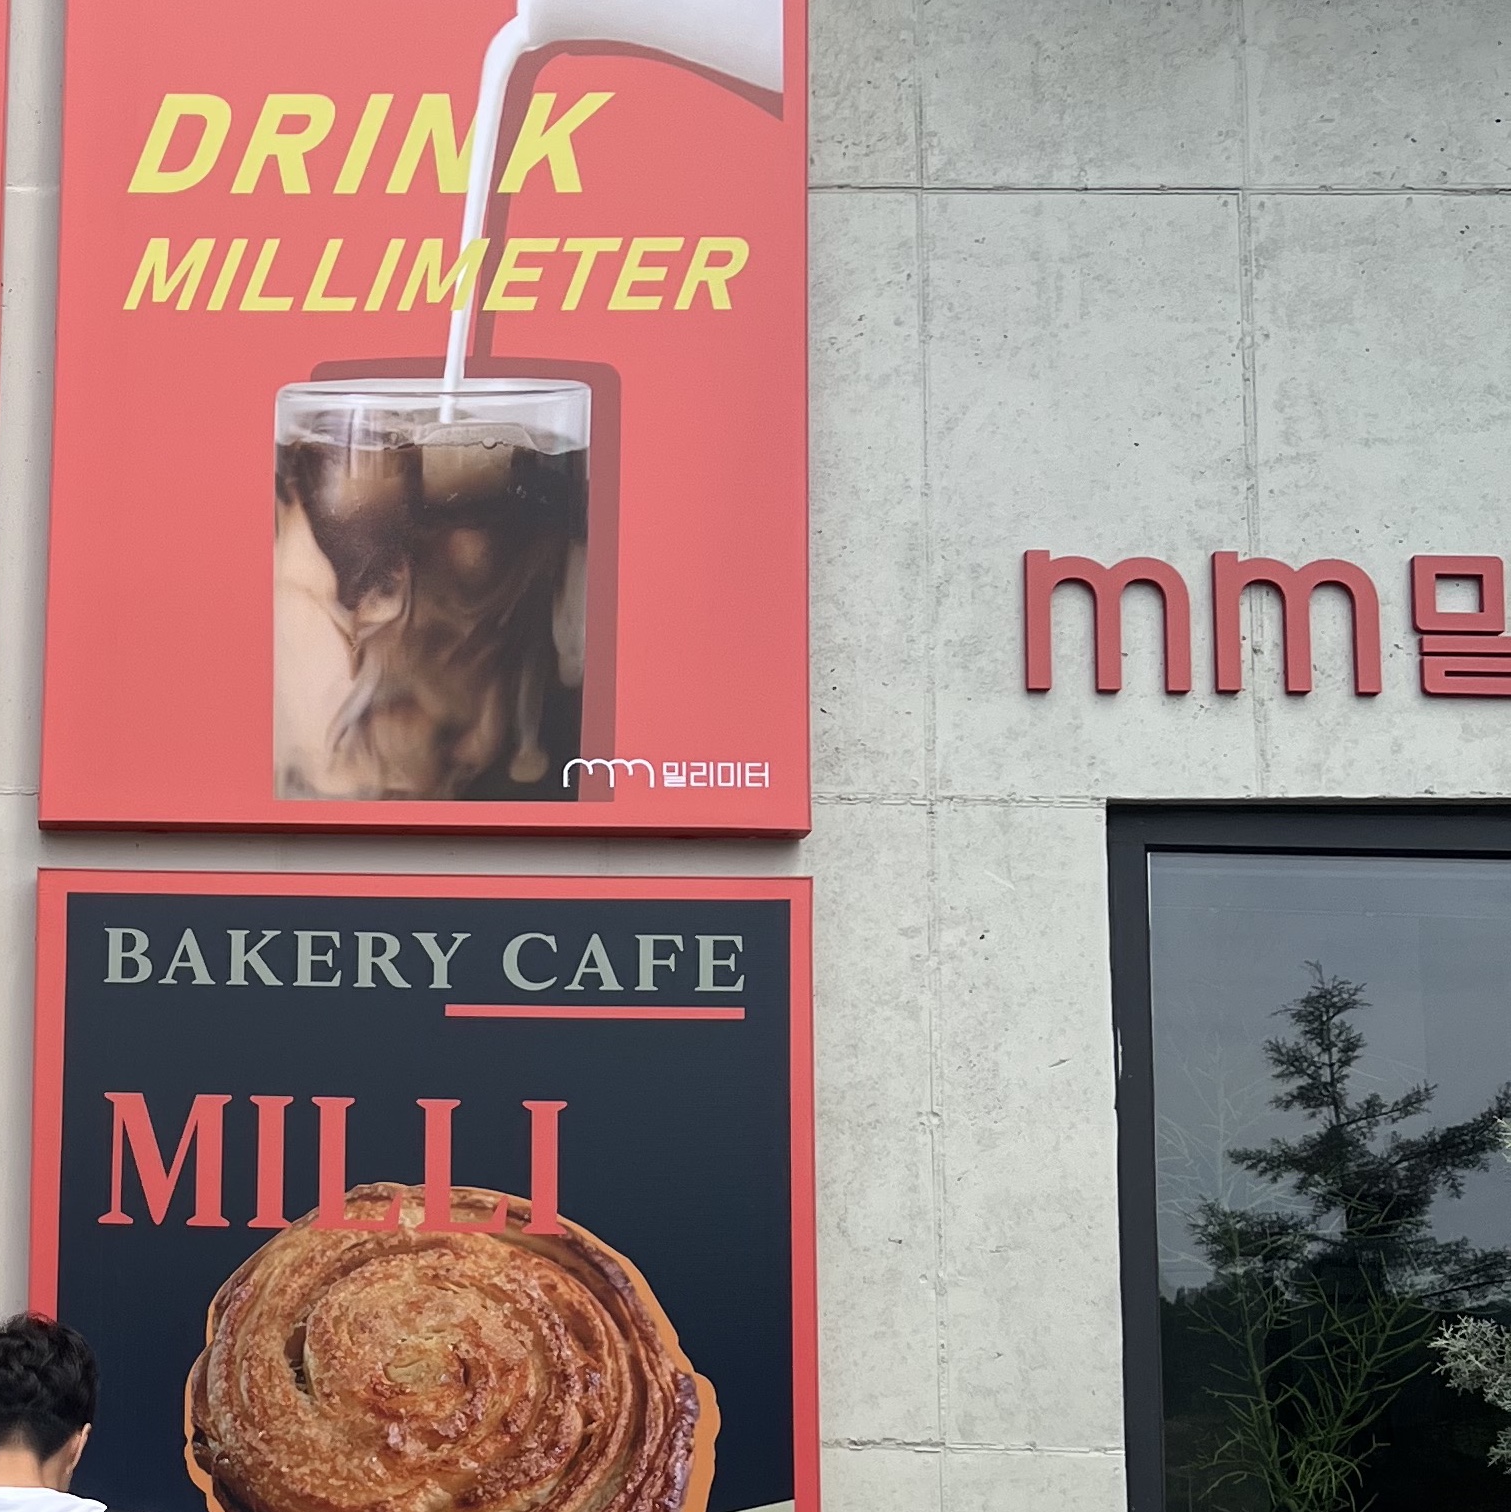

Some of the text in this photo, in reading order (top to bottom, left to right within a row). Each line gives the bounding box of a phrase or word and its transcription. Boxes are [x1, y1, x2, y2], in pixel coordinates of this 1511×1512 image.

[127, 92, 616, 196] DRINK
[122, 236, 751, 312] MILLIMETER
[662, 761, 770, 788] 밀리미터
[103, 926, 746, 993] BAKERY CAFE
[96, 1090, 568, 1236] MILLI
